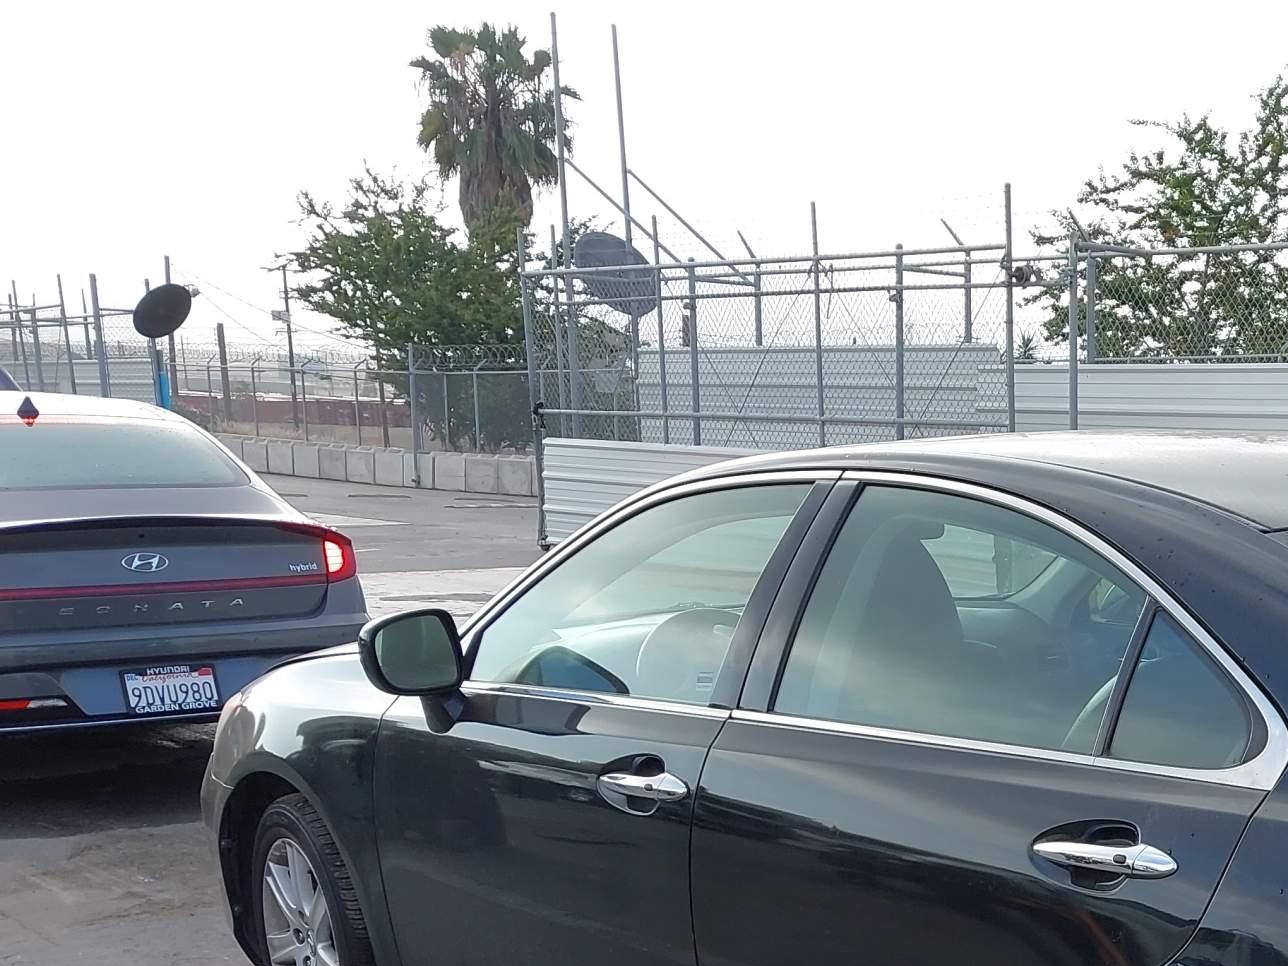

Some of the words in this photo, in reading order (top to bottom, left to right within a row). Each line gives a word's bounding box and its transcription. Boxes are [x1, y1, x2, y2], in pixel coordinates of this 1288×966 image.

[289, 562, 318, 573] hybrid
[58, 598, 244, 615] SONATA
[146, 665, 190, 675] HYUNDAI
[131, 681, 215, 708] 9DVU980
[135, 703, 180, 714] GARDEN
[181, 700, 217, 710] GROVE
